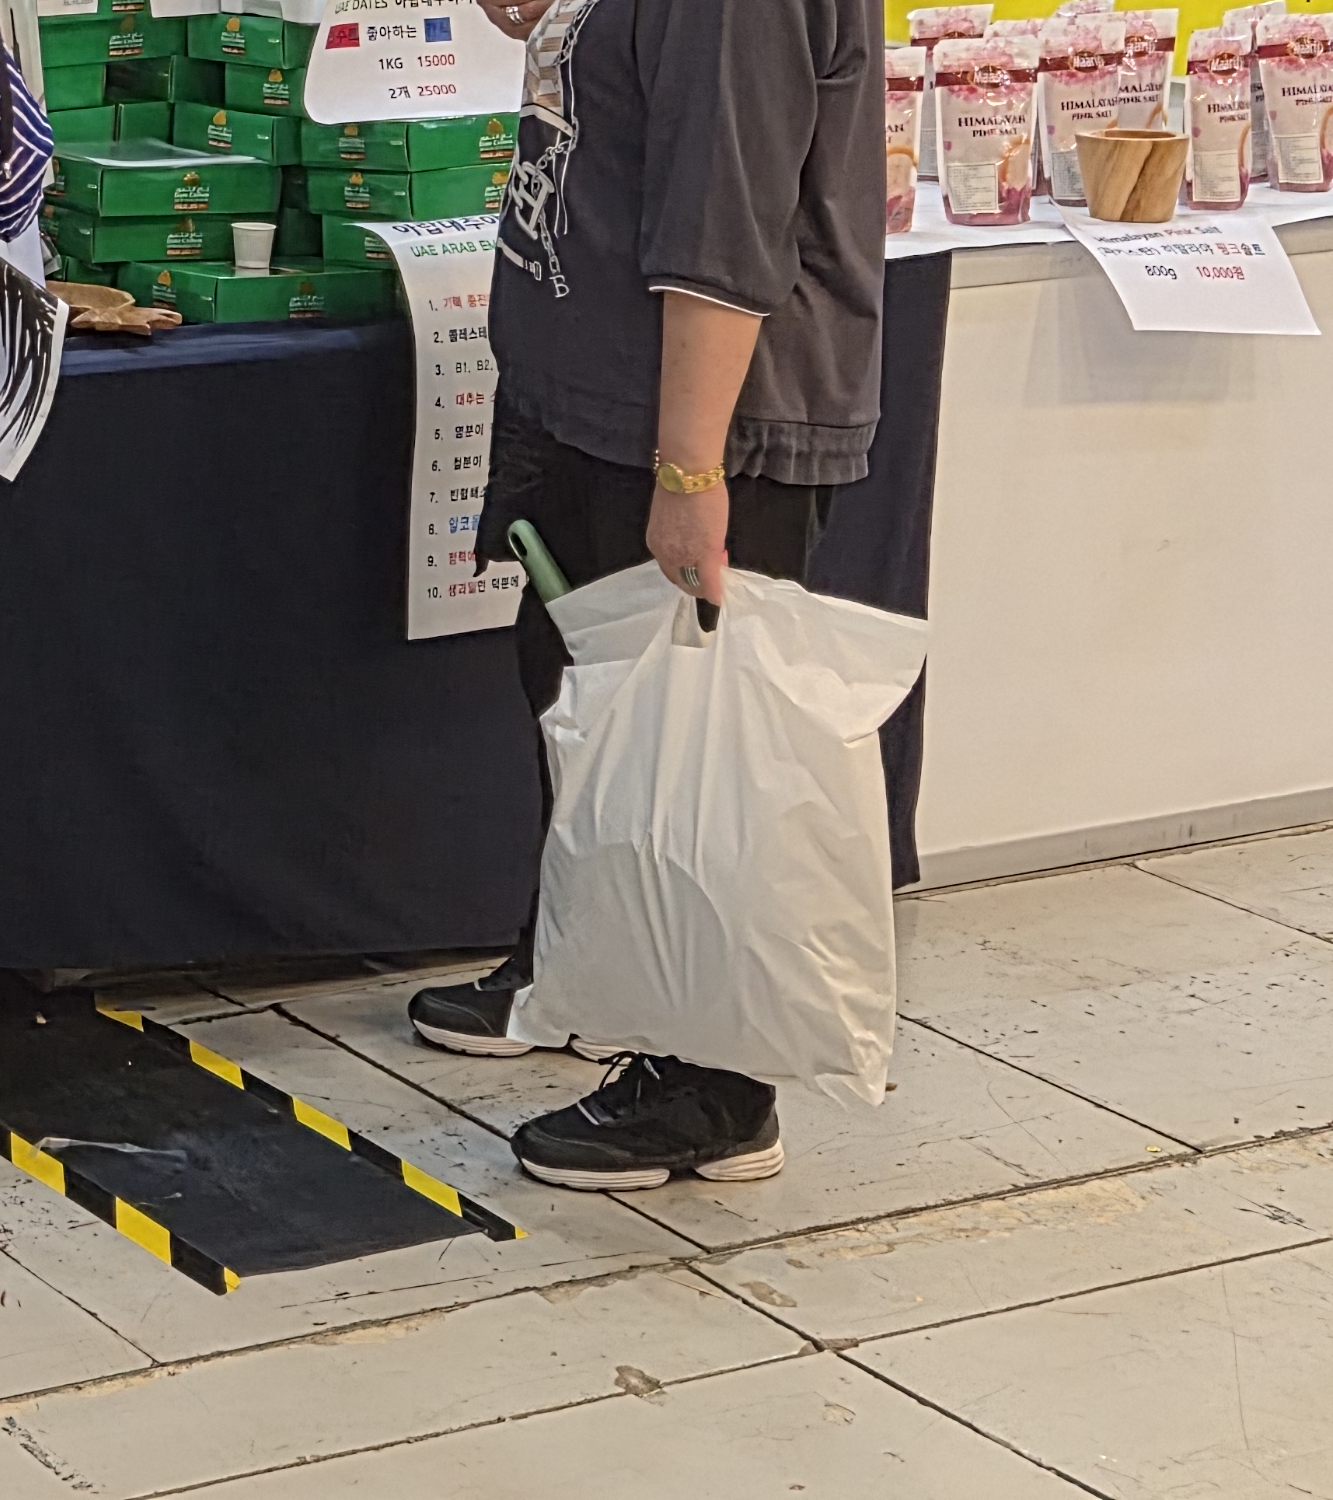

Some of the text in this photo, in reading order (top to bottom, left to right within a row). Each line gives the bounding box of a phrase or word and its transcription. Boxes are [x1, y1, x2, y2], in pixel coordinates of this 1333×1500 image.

[378, 53, 456, 71] 1KG 15000
[388, 83, 457, 100] 2개 25000
[410, 240, 477, 258] UAE ARAB
